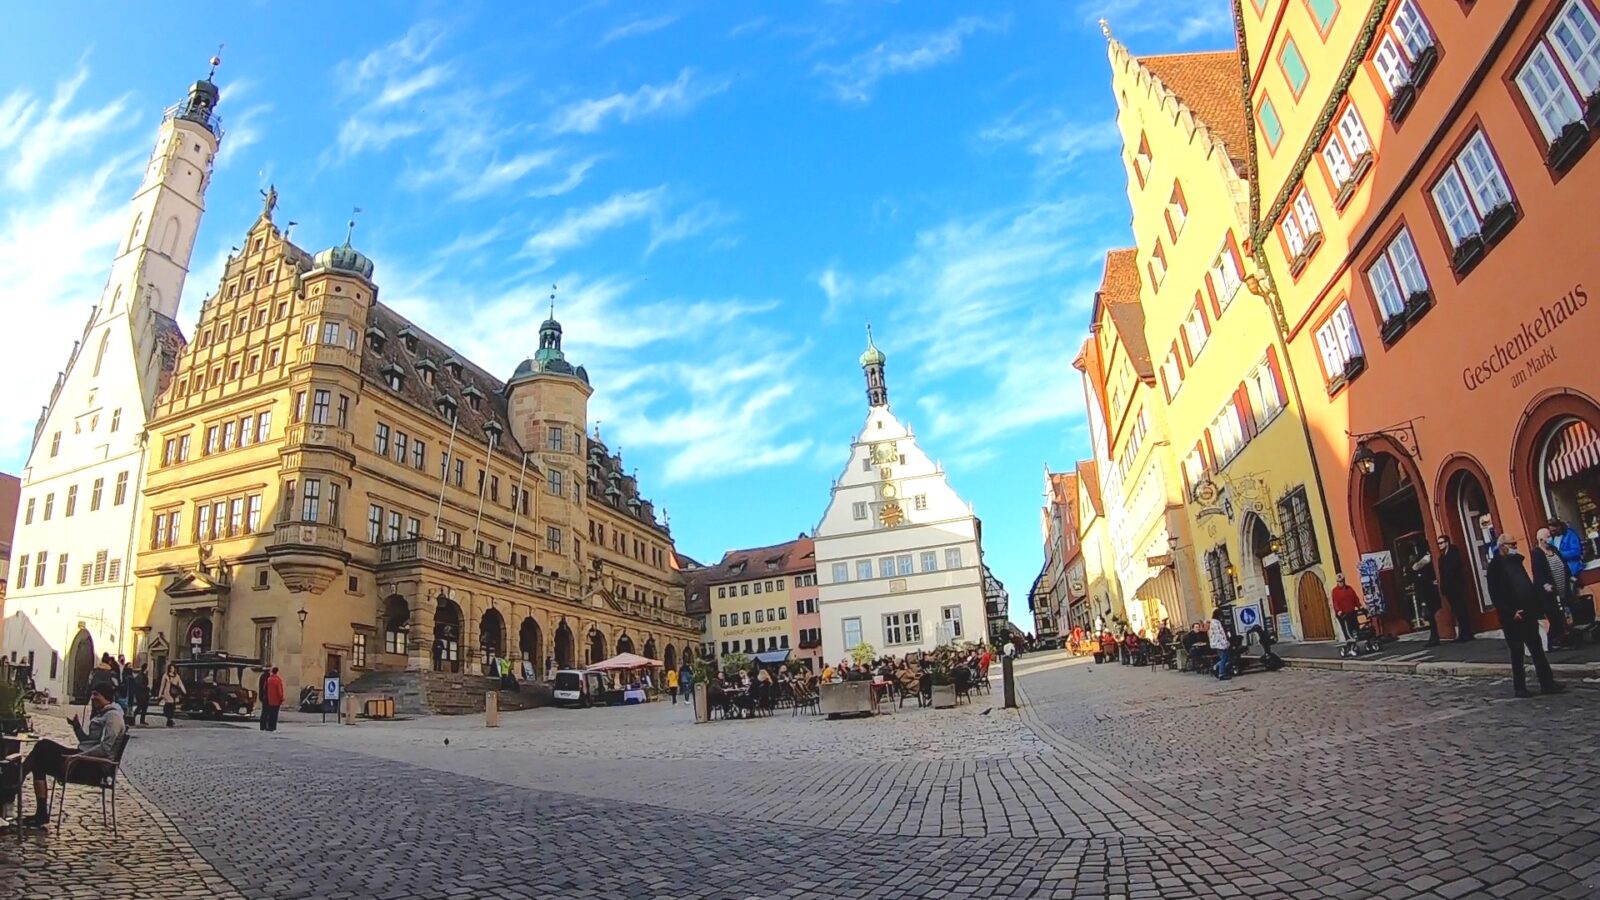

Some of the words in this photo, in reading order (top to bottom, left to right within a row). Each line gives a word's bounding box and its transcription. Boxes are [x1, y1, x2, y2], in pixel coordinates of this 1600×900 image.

[1463, 283, 1588, 391] Geschenkehaus
[1510, 369, 1527, 389] am
[1526, 344, 1558, 377] Markt
